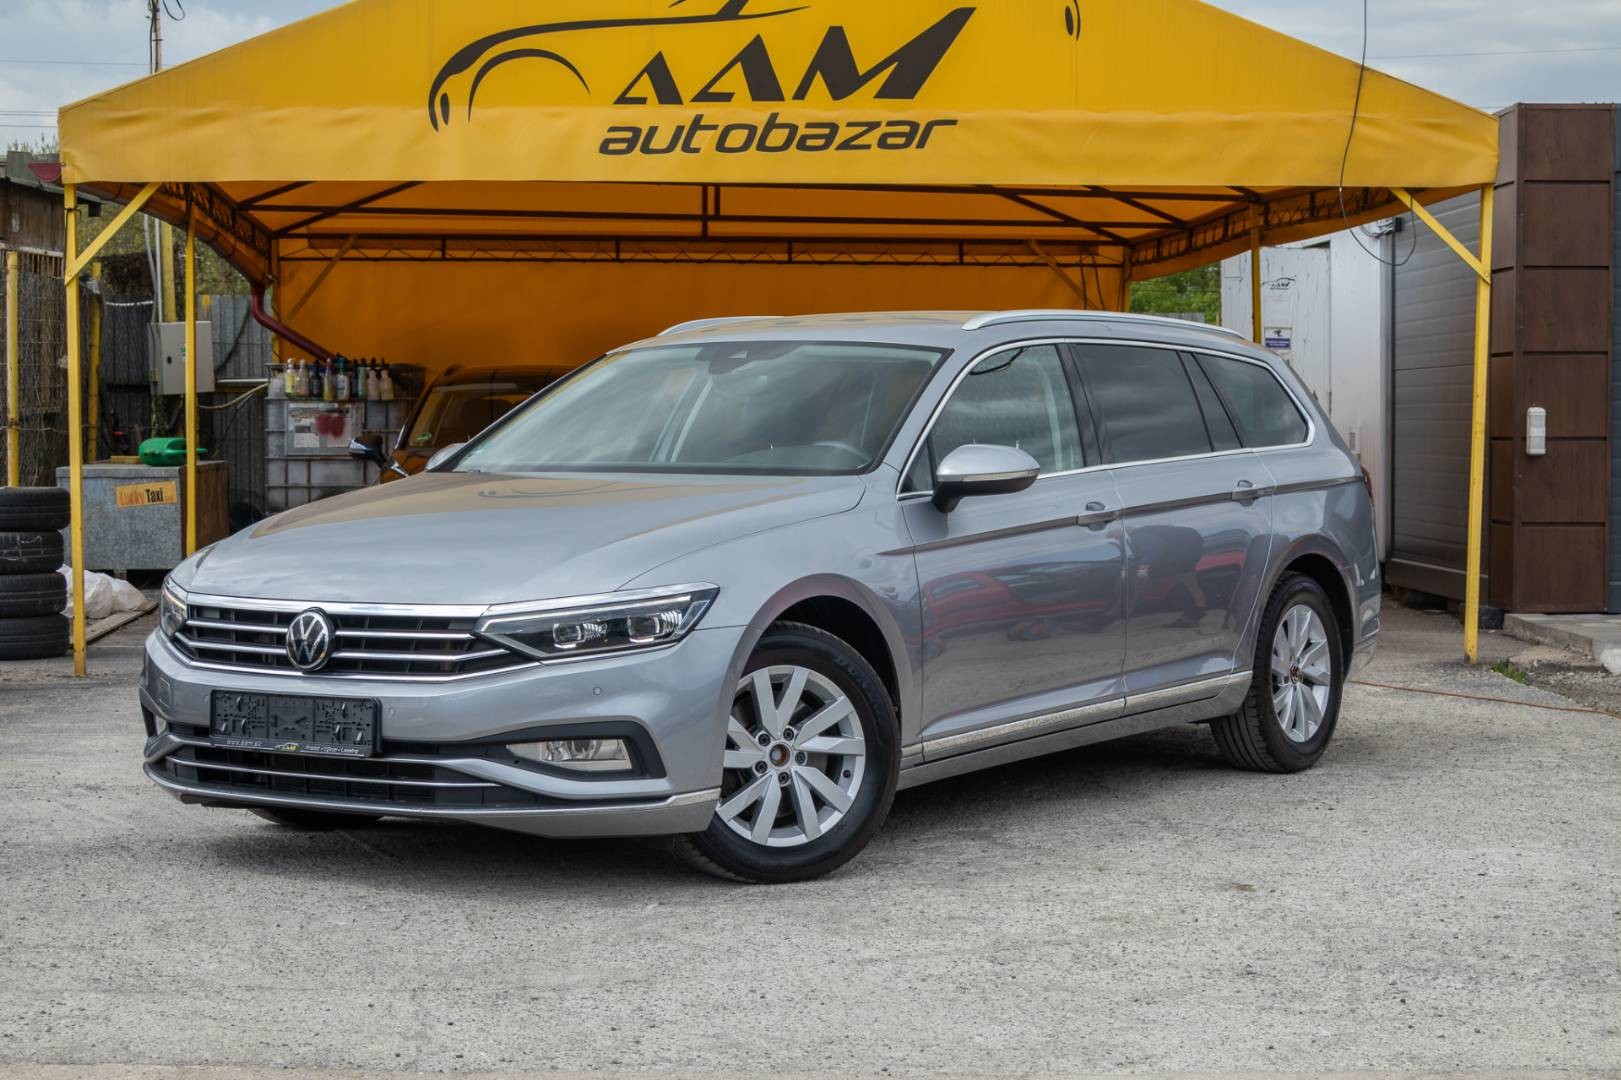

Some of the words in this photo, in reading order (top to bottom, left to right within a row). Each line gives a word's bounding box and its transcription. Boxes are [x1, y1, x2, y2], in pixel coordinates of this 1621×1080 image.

[612, 7, 977, 105] AAM
[599, 112, 958, 155] autobazar
[145, 487, 164, 503] Taxi
